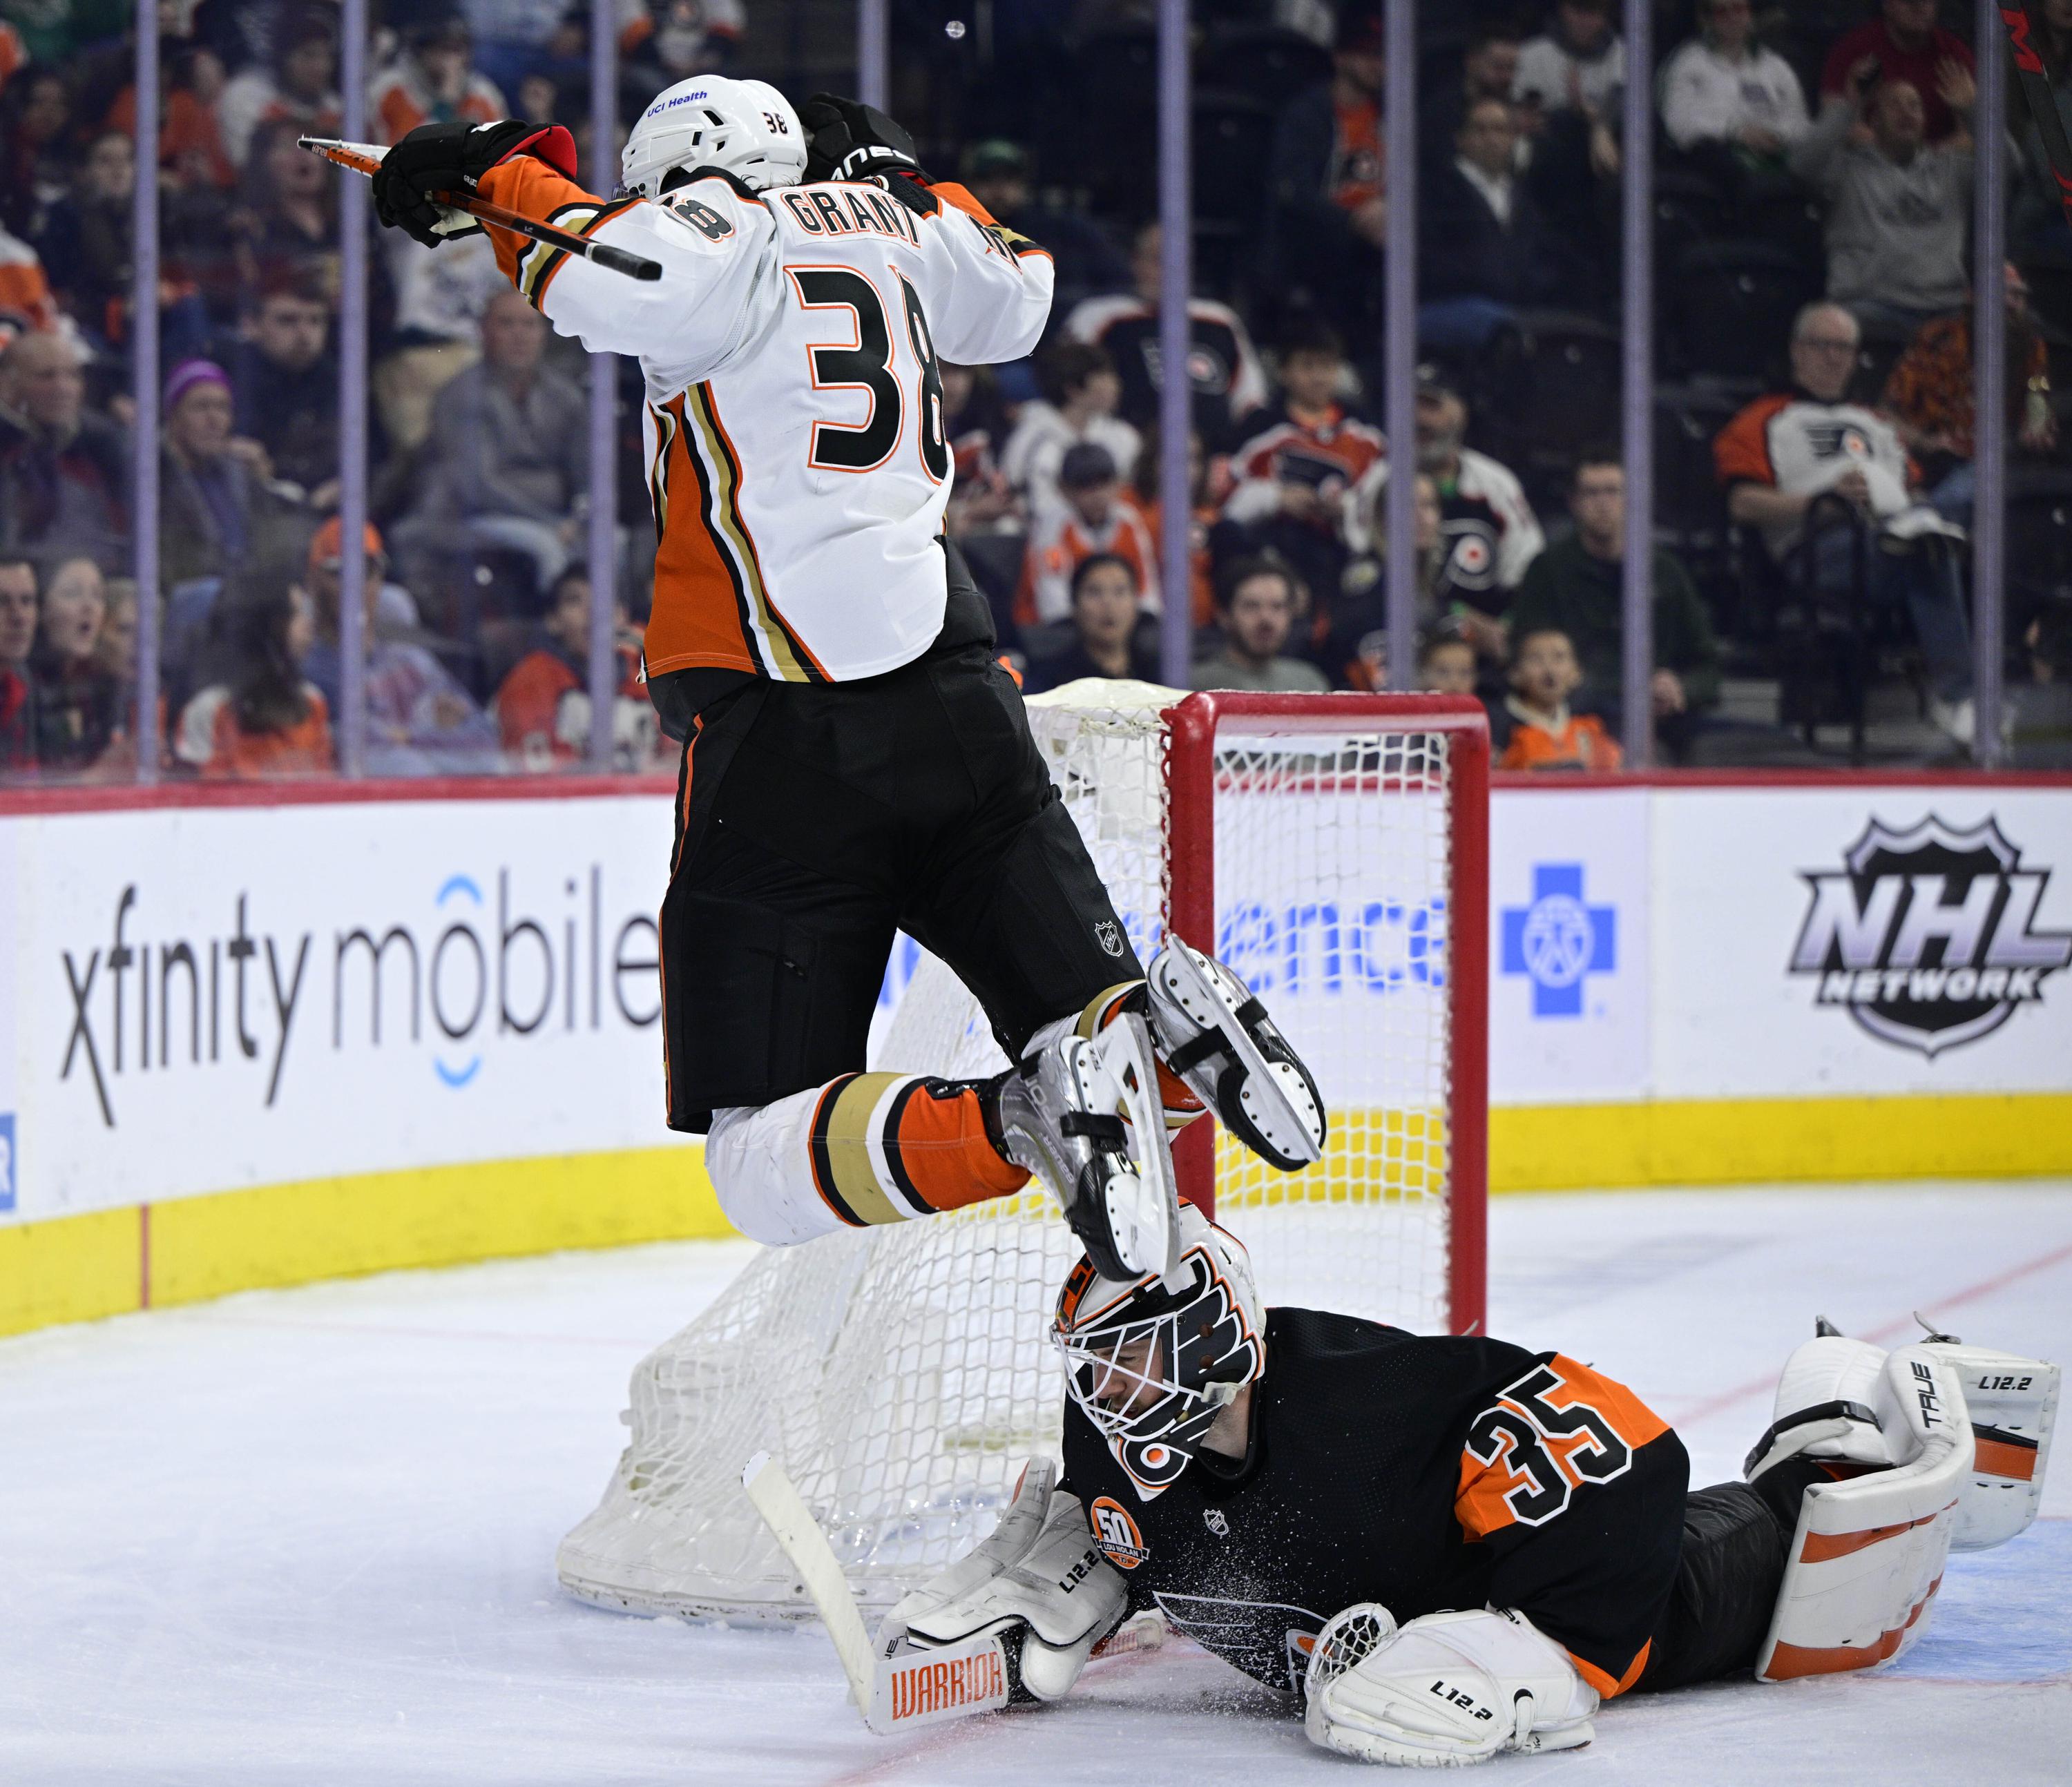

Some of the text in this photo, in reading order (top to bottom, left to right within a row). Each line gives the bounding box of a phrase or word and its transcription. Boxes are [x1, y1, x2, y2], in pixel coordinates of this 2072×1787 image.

[647, 91, 707, 117] UCI Health
[761, 112, 788, 135] 38
[780, 190, 921, 249] GRANT
[783, 264, 950, 486] 38
[1105, 930, 1117, 952] NHL
[1796, 873, 2072, 969] NHL
[61, 883, 311, 1128] xfinity
[1821, 967, 2037, 1005] NETWORK
[1910, 1360, 1943, 1429] TRUE
[1978, 1375, 2033, 1391] L12.2
[1464, 1362, 1633, 1527] 35
[1095, 1507, 1134, 1547] 50
[1103, 1541, 1139, 1558] LOU NOLAN
[1058, 1549, 1100, 1594] L12.2
[891, 1651, 1003, 1721] WARRIOR
[1430, 1680, 1493, 1721] L12.2
